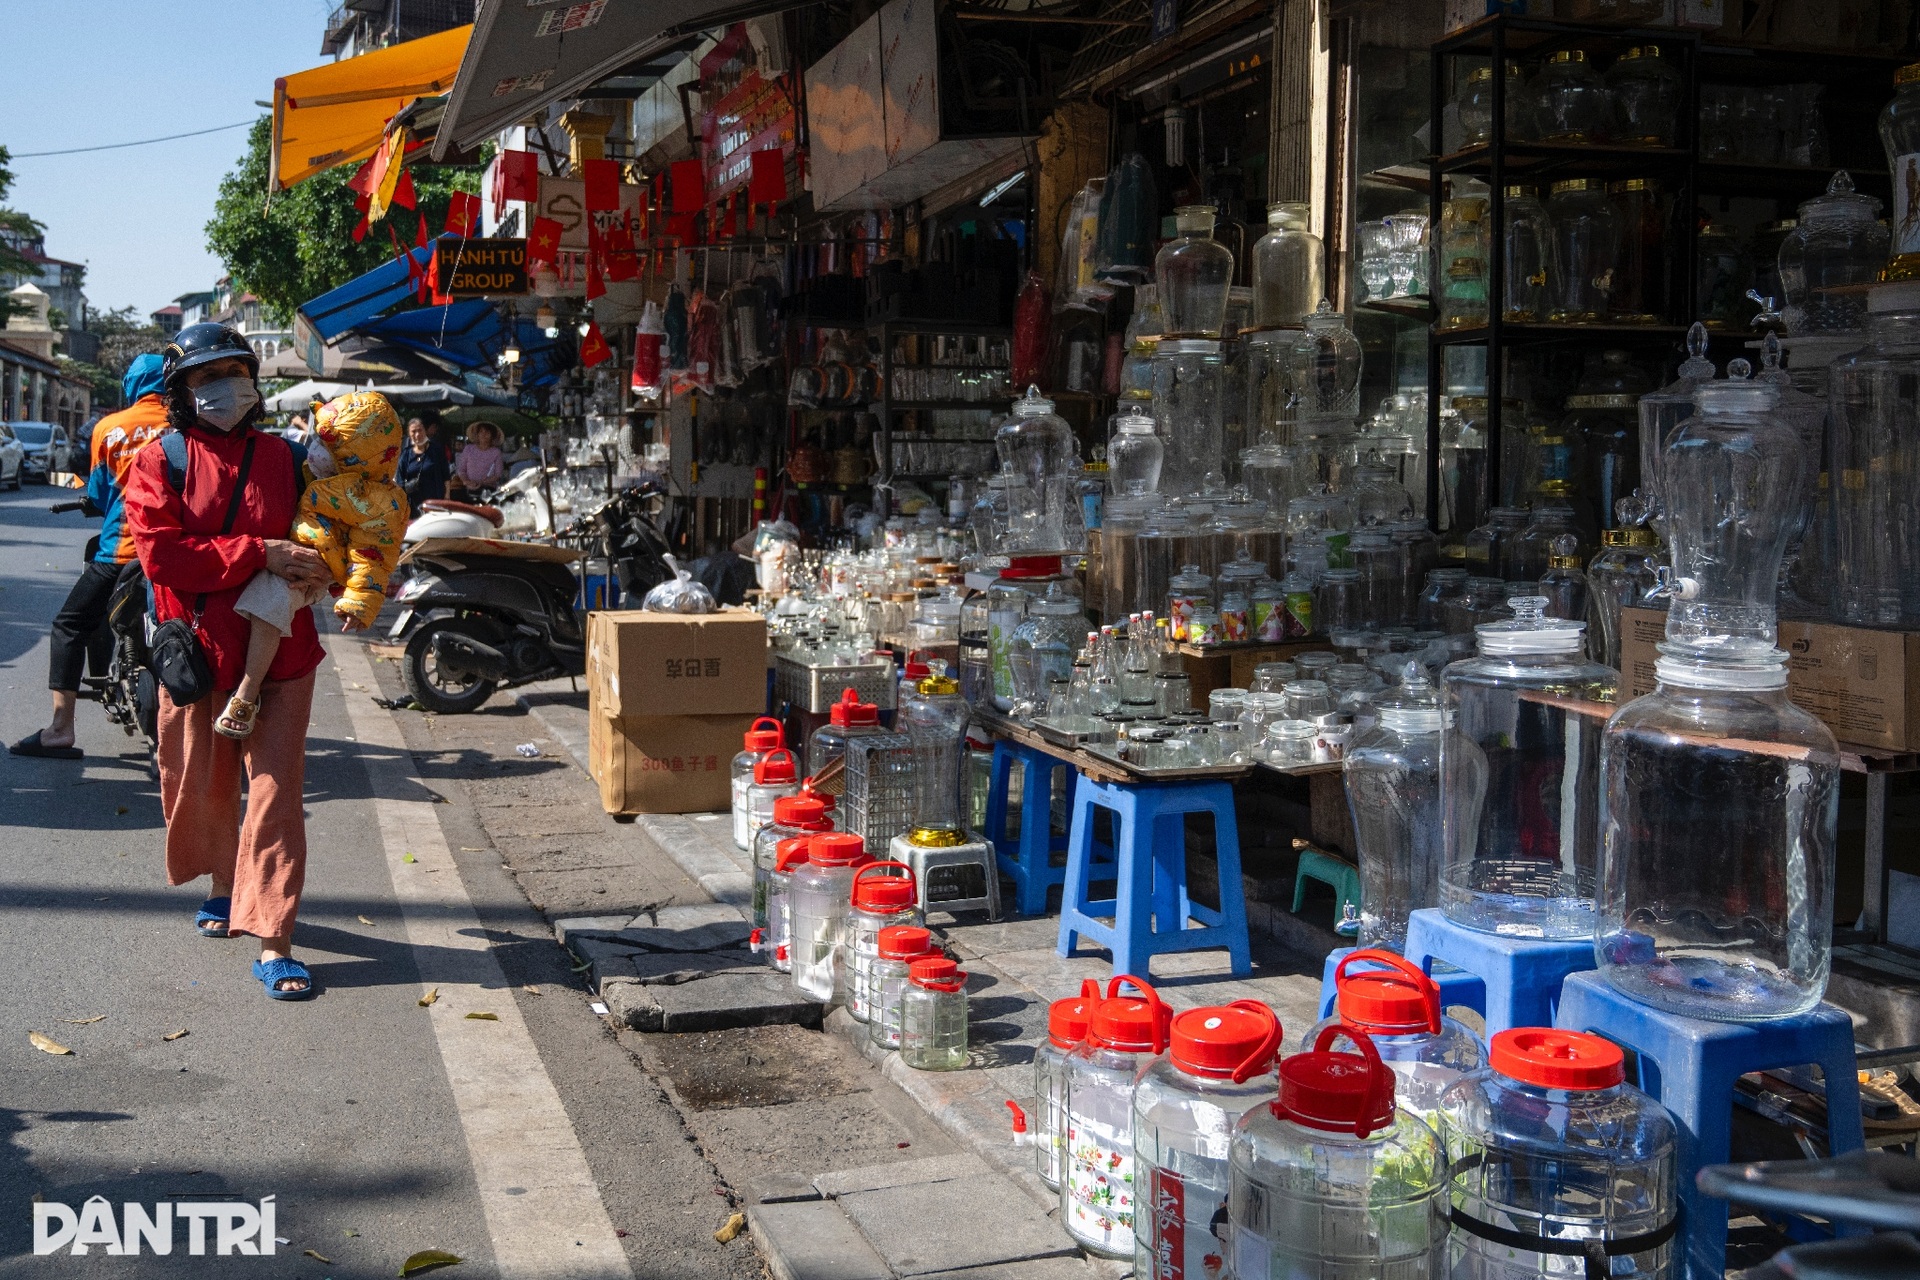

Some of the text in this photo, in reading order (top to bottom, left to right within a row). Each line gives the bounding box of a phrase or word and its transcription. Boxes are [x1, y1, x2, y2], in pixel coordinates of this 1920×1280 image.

[441, 247, 524, 267] HẠNH TÚ
[452, 273, 515, 288] GROUP
[665, 657, 721, 679] 星巴克
